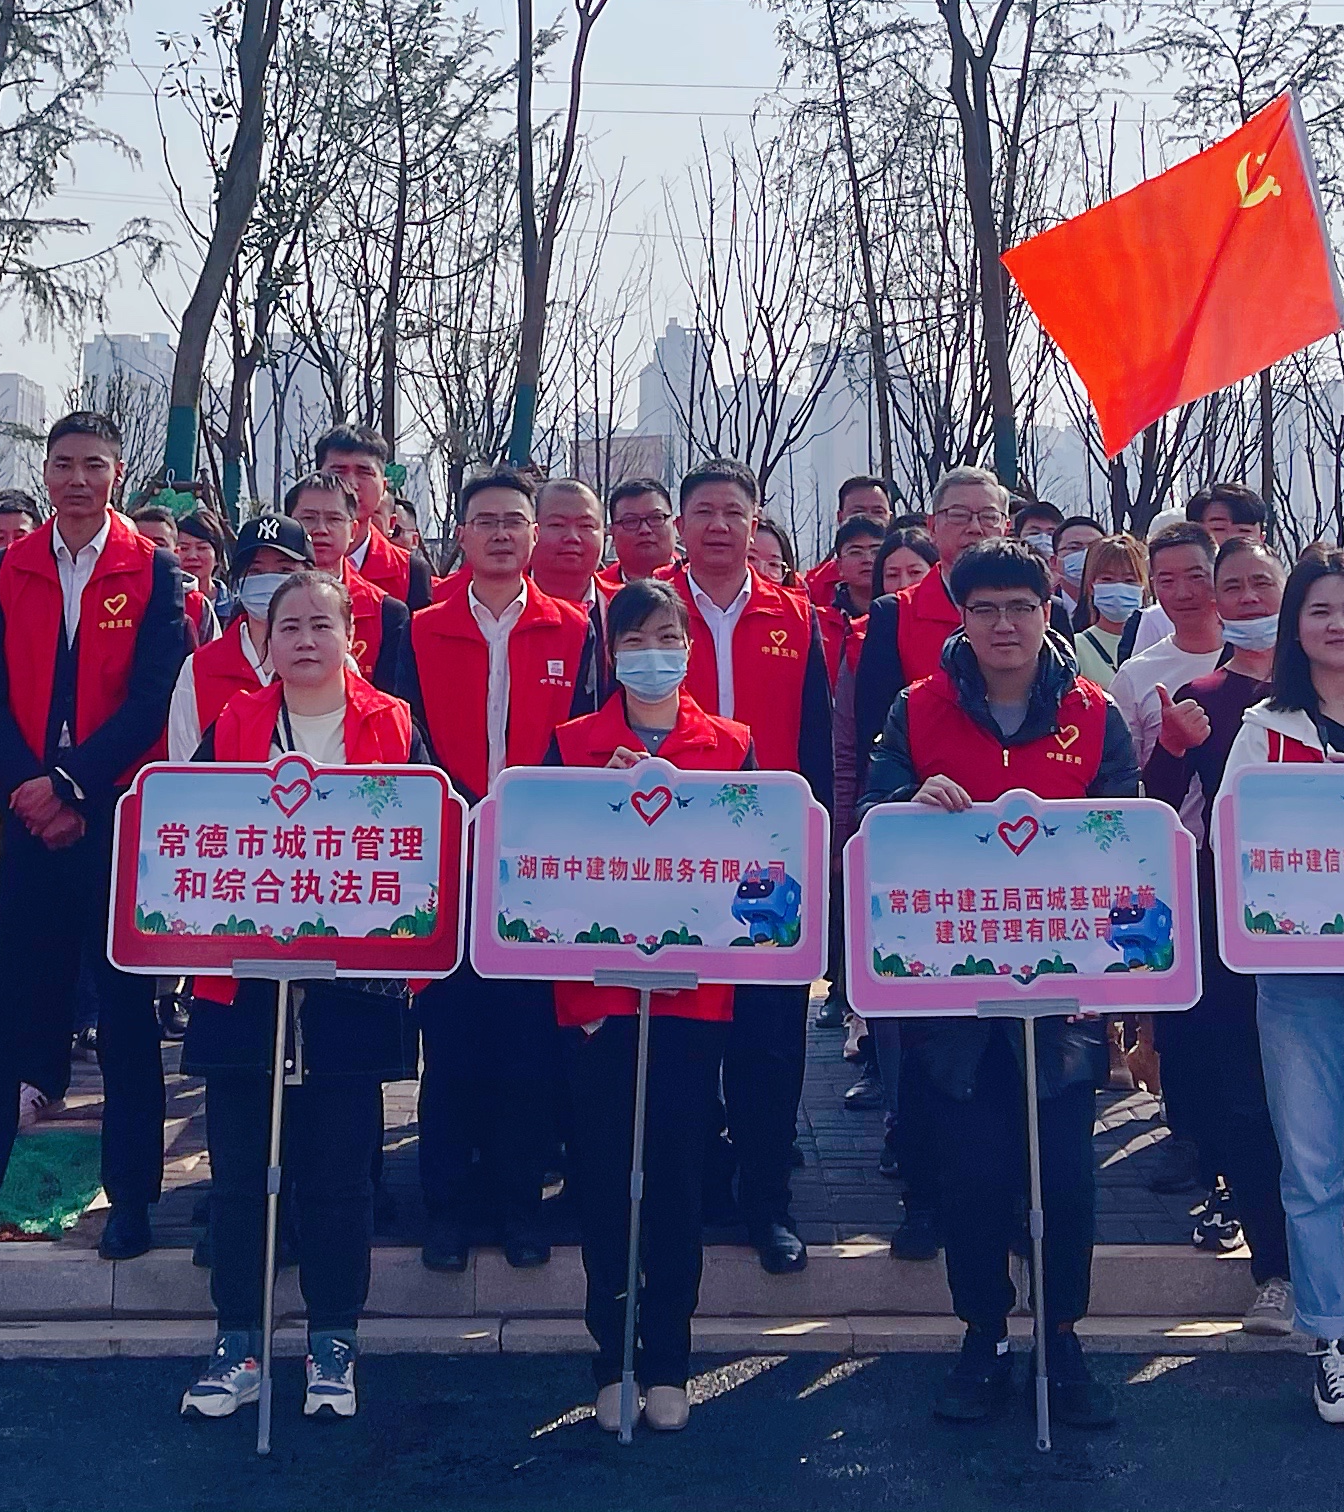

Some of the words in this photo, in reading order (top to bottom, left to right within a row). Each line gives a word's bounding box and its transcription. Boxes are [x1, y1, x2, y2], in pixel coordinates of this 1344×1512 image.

[257, 518, 280, 539] NY
[157, 822, 424, 861] 常德市城市管理
[517, 854, 786, 885] 湖南中建物业服务有限公司
[174, 868, 401, 905] 和综合执法局
[888, 885, 1157, 914] 常德中建五局西城基础设施
[935, 917, 1113, 944] 建设管理有限公司
